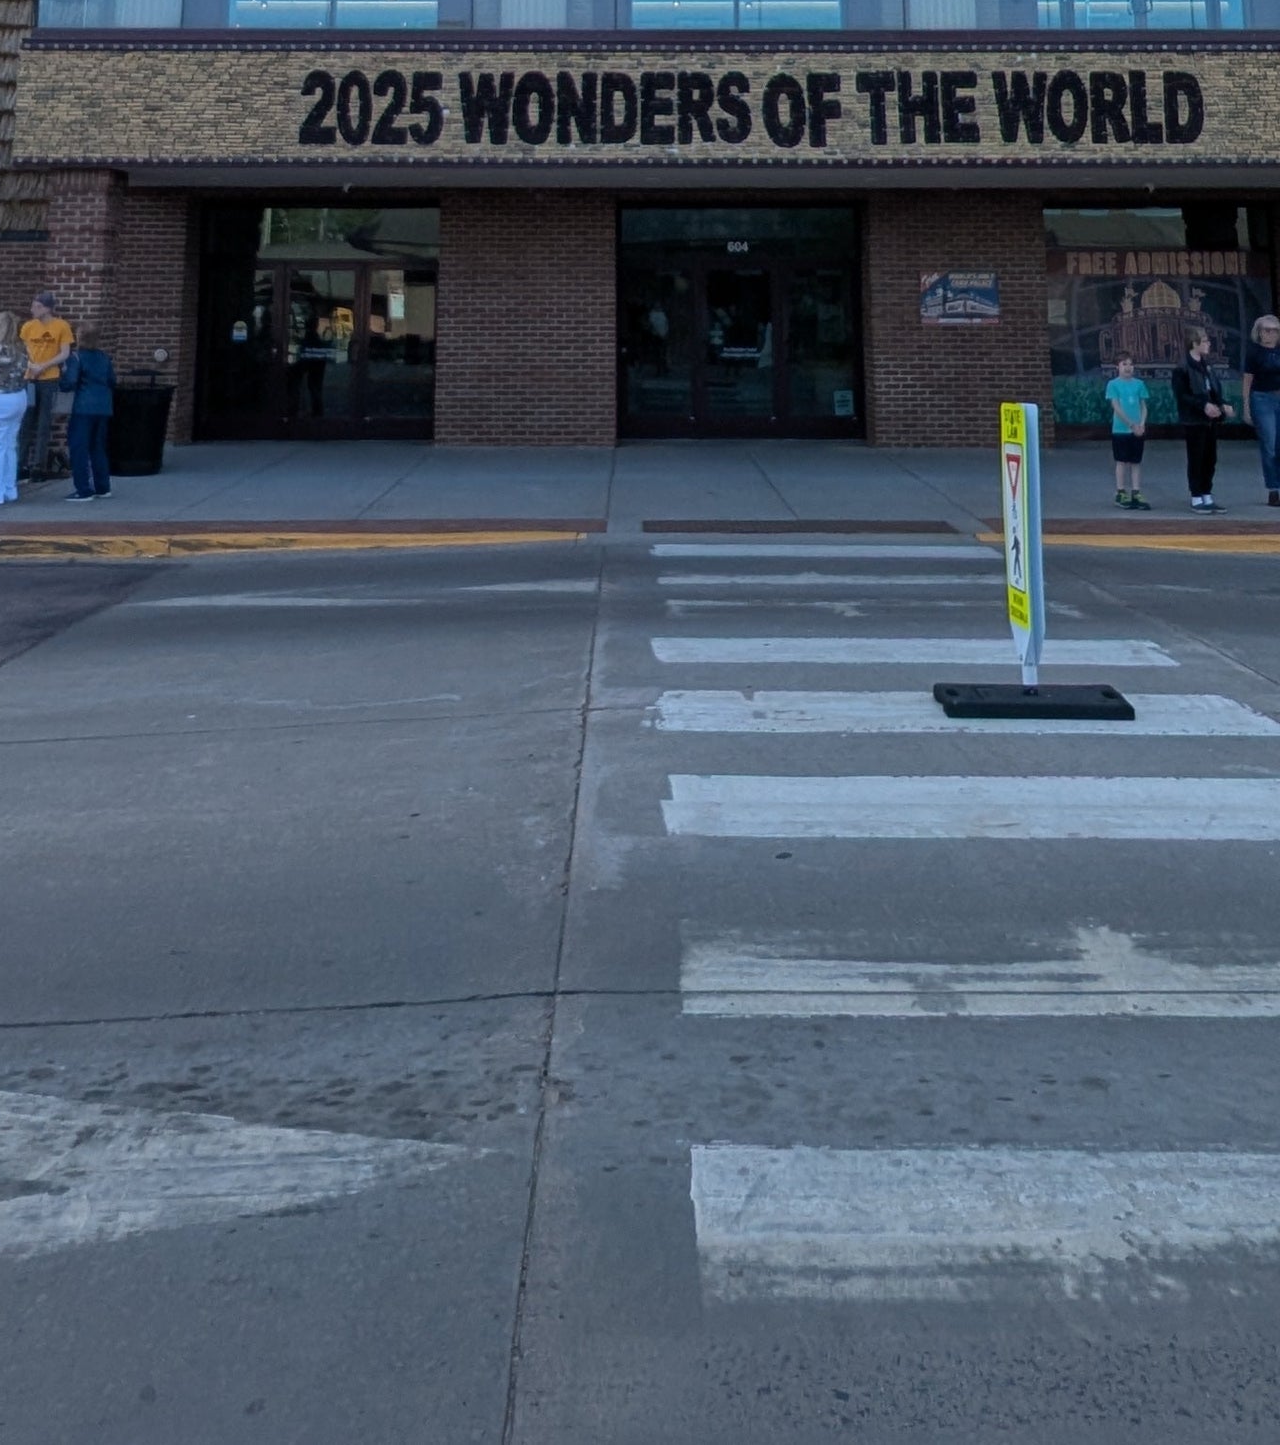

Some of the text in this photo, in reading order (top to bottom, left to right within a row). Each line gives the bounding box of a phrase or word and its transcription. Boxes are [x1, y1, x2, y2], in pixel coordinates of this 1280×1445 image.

[298, 69, 1205, 148] 2025 WONDERS OF THE WORLD
[726, 241, 749, 252] 604
[1066, 251, 1116, 274] FREE
